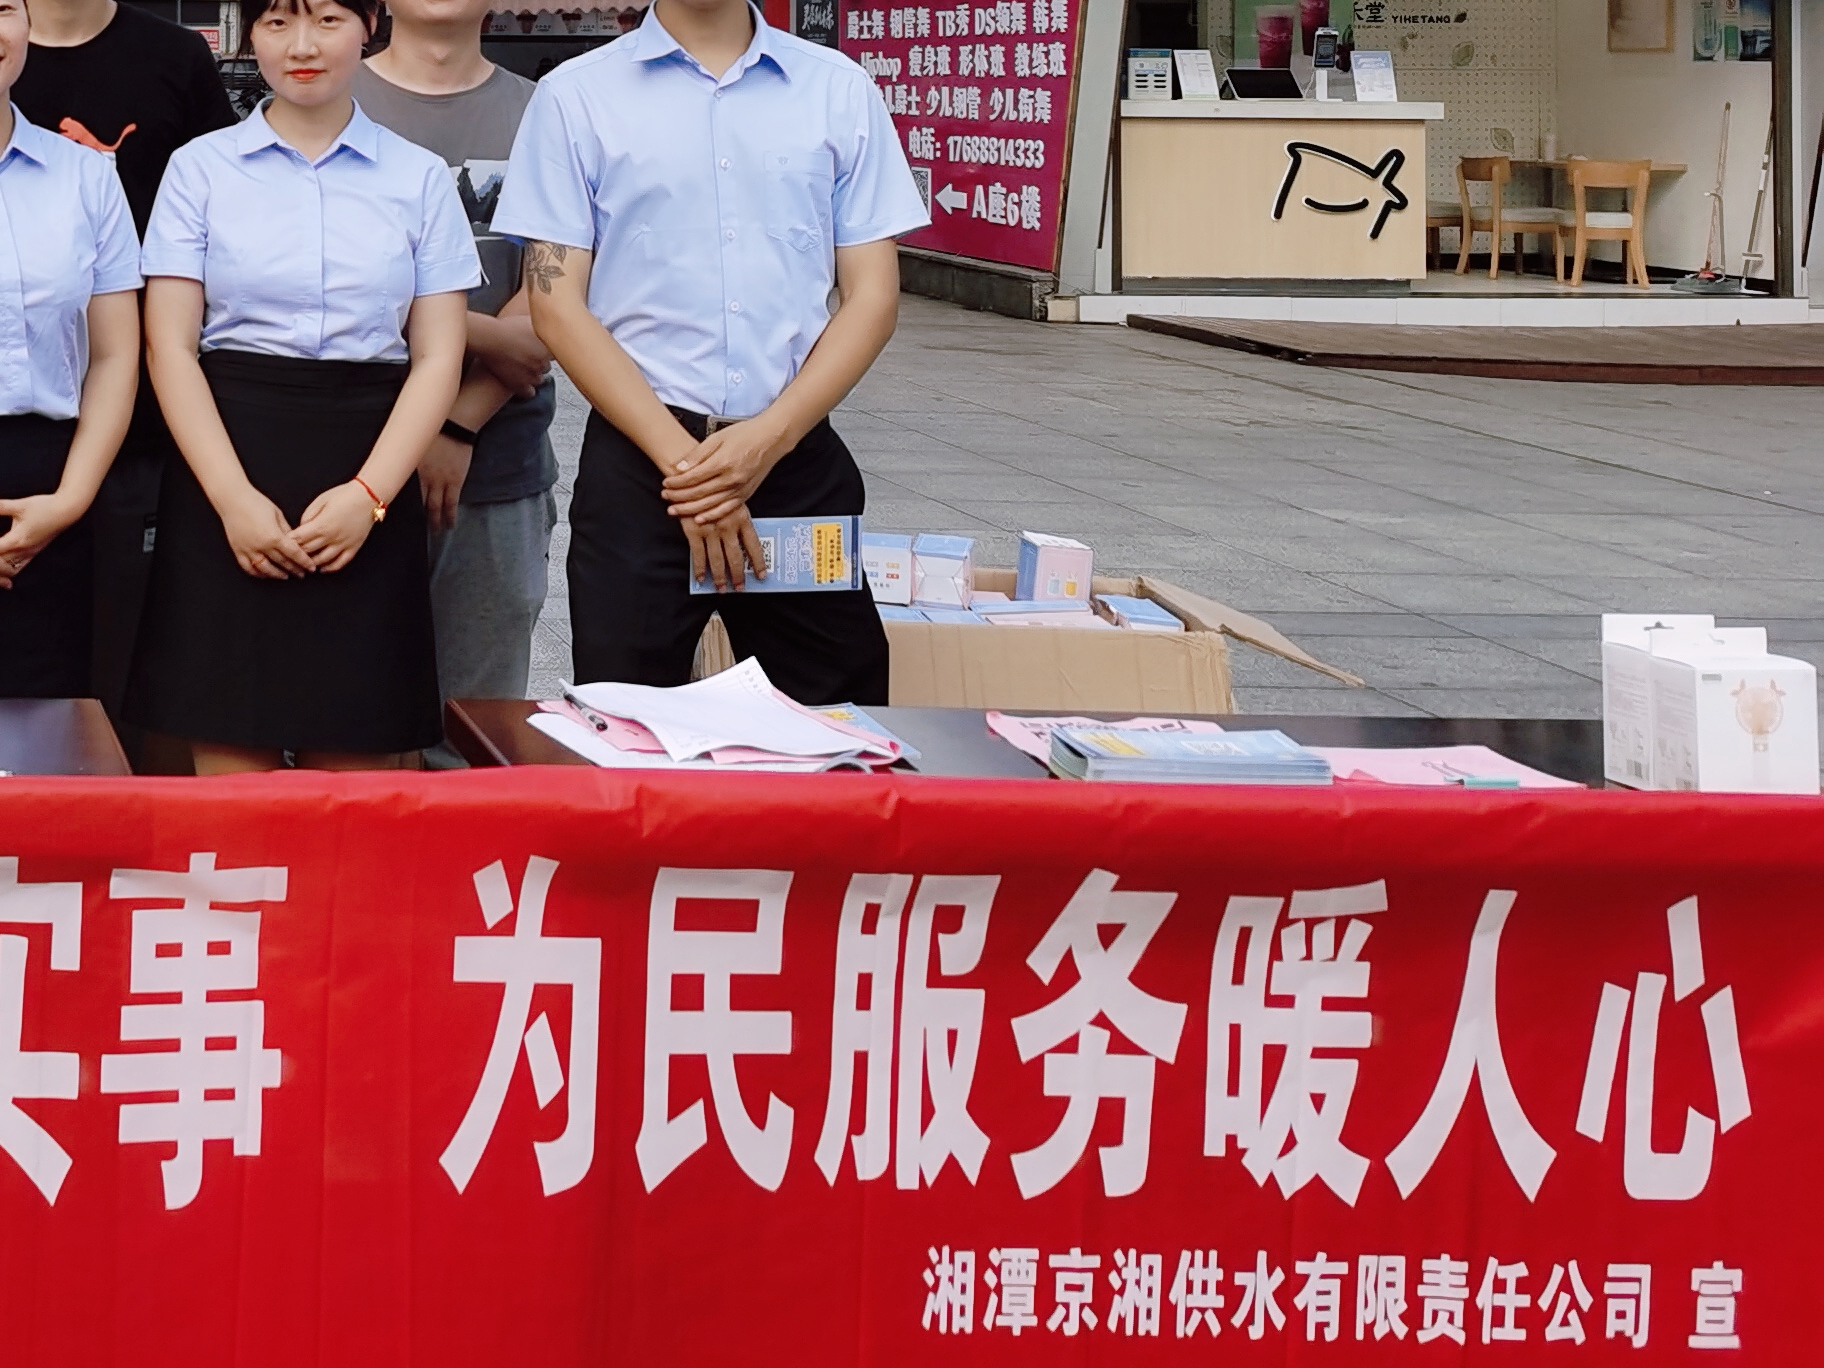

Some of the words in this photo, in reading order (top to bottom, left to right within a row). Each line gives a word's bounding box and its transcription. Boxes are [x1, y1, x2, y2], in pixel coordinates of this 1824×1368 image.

[1392, 14, 1451, 25] YIHETANG
[876, 84, 921, 117] 儿爵士
[971, 182, 1043, 232] A座6楼
[439, 854, 1753, 1209] 为民服务暖人心
[922, 1245, 1652, 1350] 湘潭京湘供水有限责任公司
[1689, 1260, 1744, 1350] 宣
